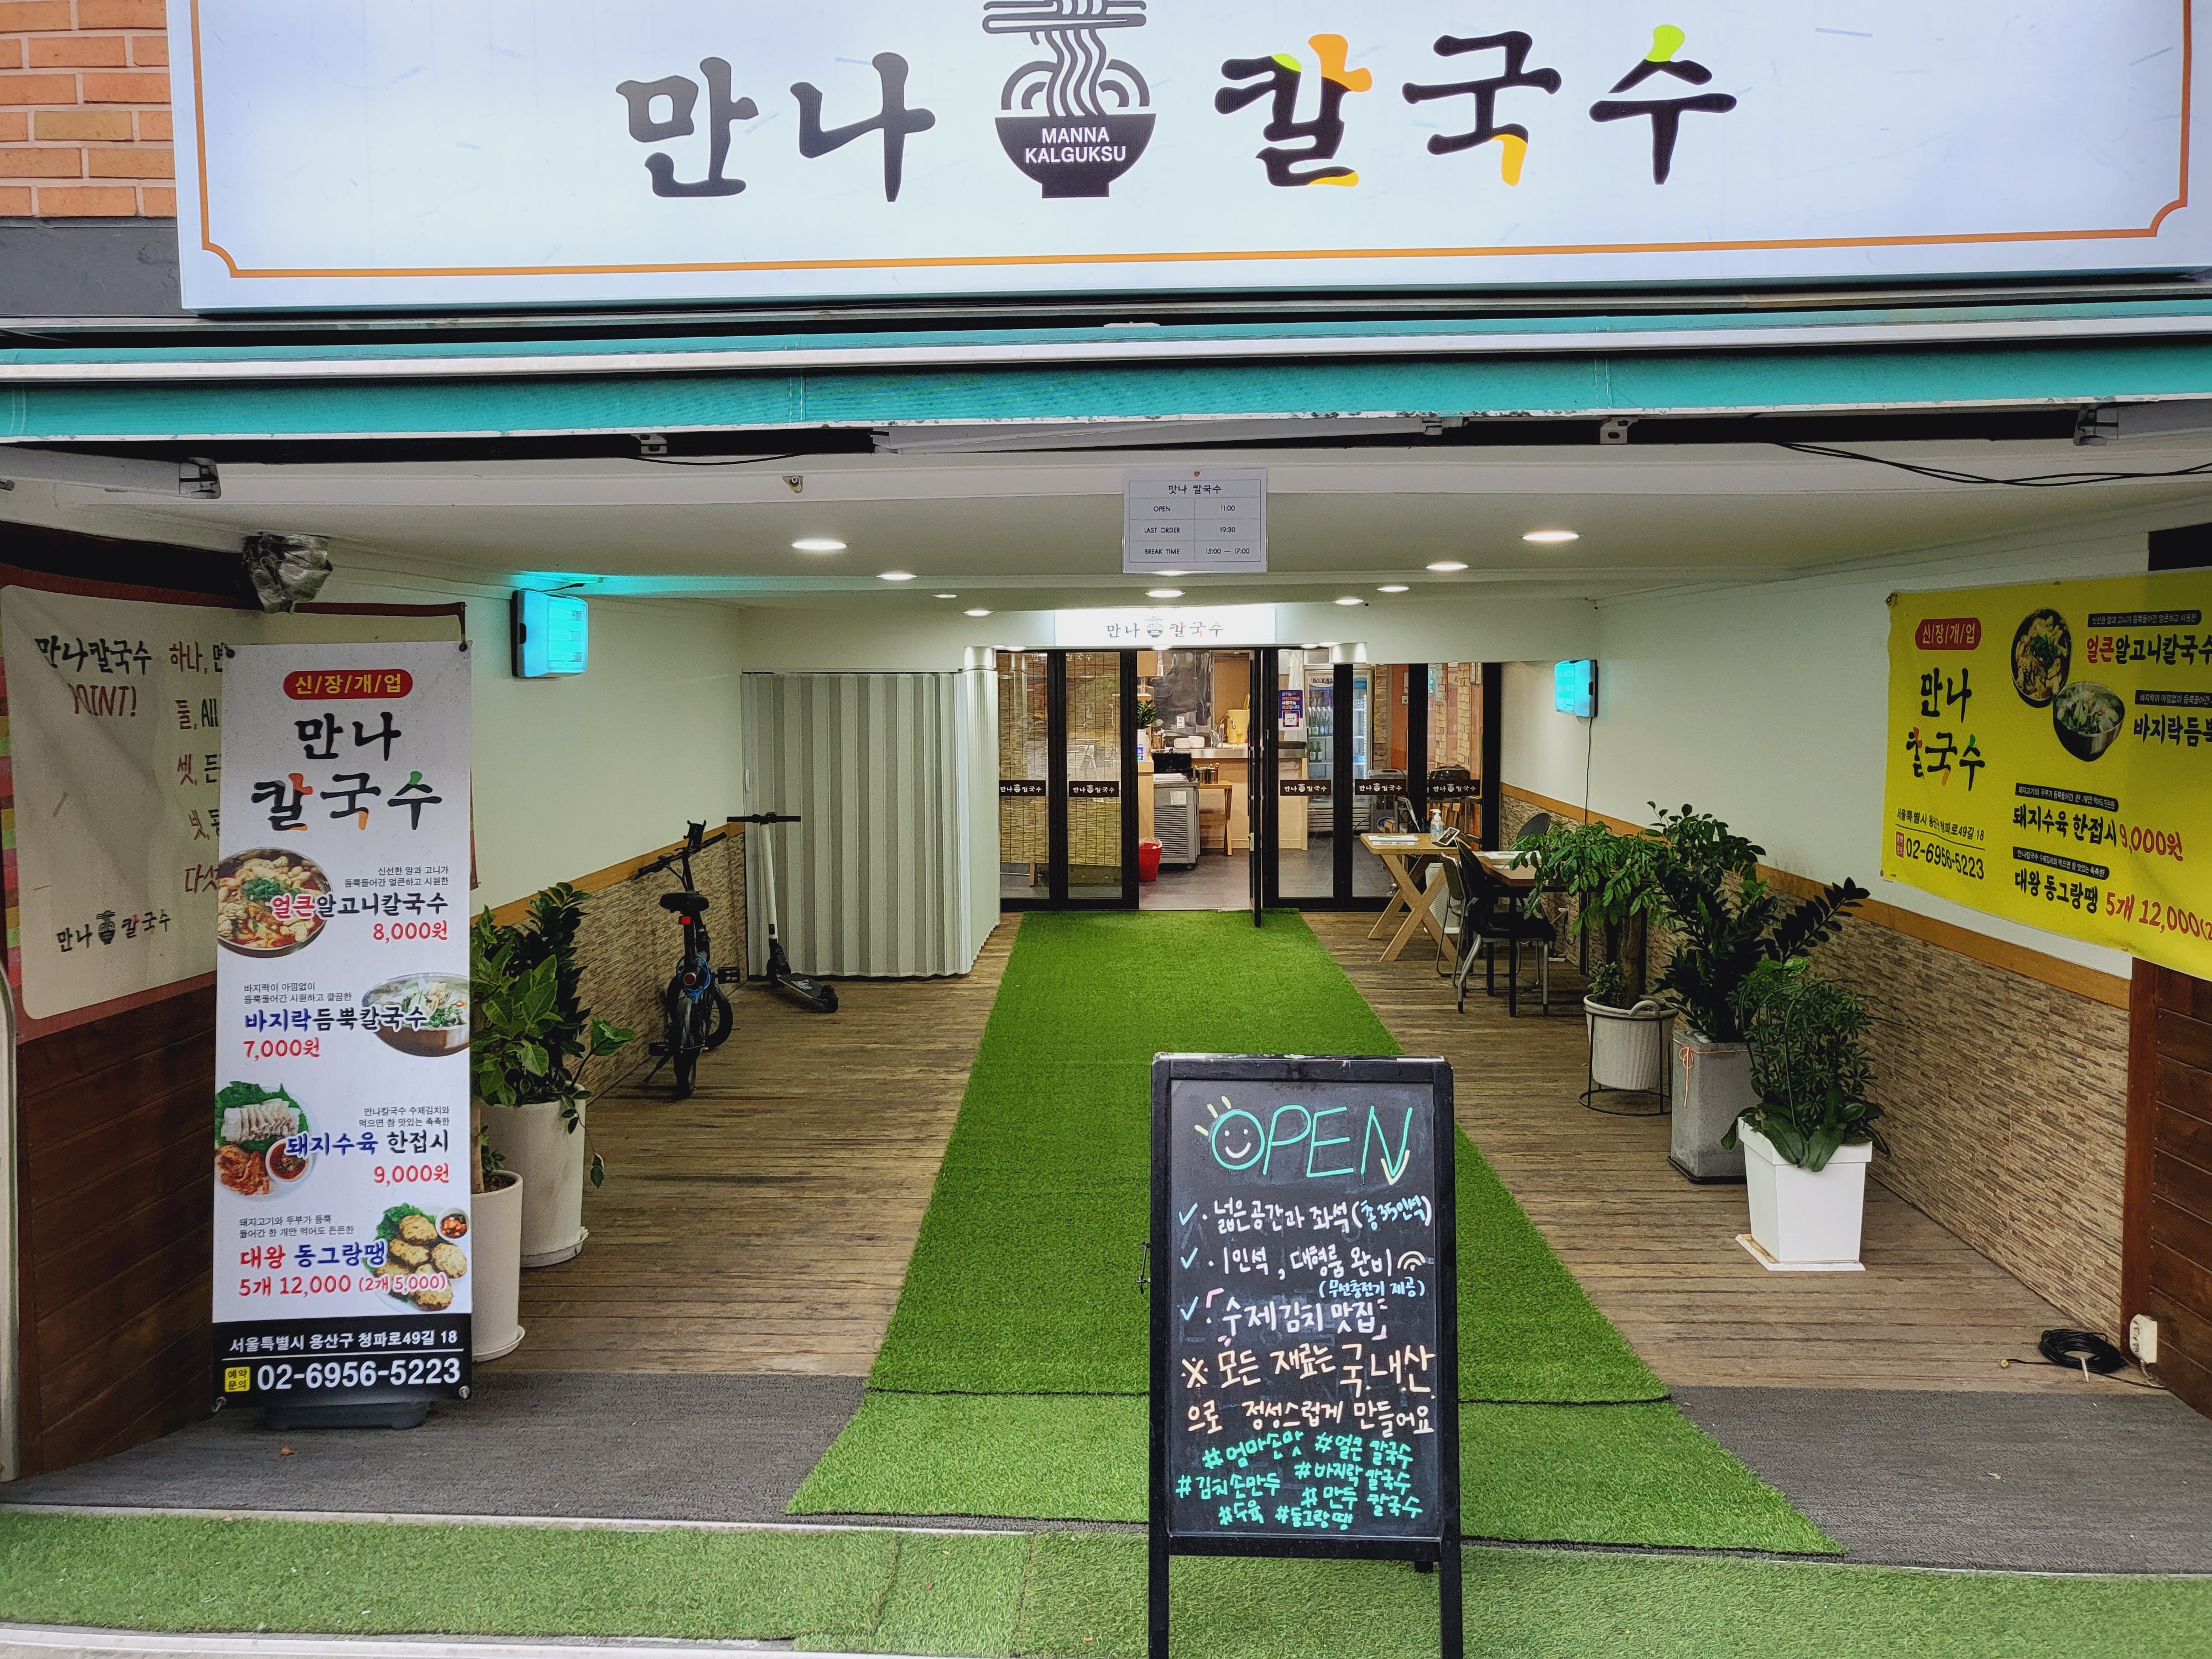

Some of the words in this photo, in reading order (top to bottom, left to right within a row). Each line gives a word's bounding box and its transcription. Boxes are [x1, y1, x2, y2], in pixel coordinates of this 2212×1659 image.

[616, 52, 935, 201] 만나
[1215, 24, 1736, 186] 칼국수
[1041, 127, 1110, 144] MANNA
[1025, 145, 1126, 163] KALGUKSU
[1168, 484, 1187, 494] 맛나
[1193, 484, 1222, 494] 칼국수
[1107, 623, 1140, 638] 만나
[1170, 621, 1224, 638] 칼국수
[2117, 615, 2131, 624] 고니가
[2159, 614, 2179, 623] 얼큰하고
[2180, 613, 2196, 622] 시원한
[1922, 622, 1975, 644] 신/장/개/업
[34, 635, 152, 675] 만나칼국수
[2087, 633, 2212, 666] 얼큰알고니칼국수
[295, 674, 401, 694] 신/장/개/업
[1921, 667, 1972, 723] 만나
[2140, 693, 2160, 702] 바지락이
[175, 700, 197, 730] 둘,
[295, 712, 401, 761] 만나
[251, 771, 442, 831] 칼국수
[1976, 830, 1984, 841] 18
[2012, 803, 2069, 838] 돼지수육
[2073, 813, 2117, 848] 한접시
[2119, 823, 2183, 862] 9,000원
[378, 867, 402, 875] 신선한
[405, 866, 421, 875] 알과
[425, 865, 448, 874] 고니가
[1906, 837, 1985, 880] 02-6956-5223
[344, 878, 386, 888] 듬뿍들어간
[389, 878, 422, 886] 얼큰하고
[424, 877, 448, 885] 시원한
[2015, 867, 2041, 897] 대왕
[2044, 874, 2098, 914] 동그랑땡
[2105, 891, 2135, 924] 5개
[272, 891, 449, 920] 얼큰알고니칼국수
[56, 924, 92, 952] 만나
[121, 909, 170, 939] 칼국수
[373, 920, 447, 943] 8,000원
[244, 983, 278, 993] 바지락이
[281, 982, 315, 992] 아낌없이
[290, 993, 324, 1003] 시원하고
[327, 992, 352, 1001] 깔끔한
[244, 1005, 428, 1033] 바지락듬뿍칼국수
[243, 1036, 320, 1061] 7,000원
[359, 1119, 384, 1128] 먹으면
[387, 1118, 395, 1127] 참
[398, 1118, 422, 1127] 맛있는
[425, 1117, 450, 1126] 촉촉한
[364, 1107, 406, 1117] 만나칼국수
[409, 1106, 450, 1115] 수제김치와
[285, 1131, 379, 1156] 돼지수육
[387, 1129, 449, 1154] 한접시
[1211, 1104, 1413, 1178] OPEN
[374, 1162, 449, 1187] 9,000원
[239, 1216, 283, 1227] 돼지고기와
[286, 1215, 311, 1225] 두부가
[315, 1214, 331, 1224] 듬뿍
[1214, 1196, 1250, 1234] 넓은
[1251, 1200, 1305, 1232] 공간과
[239, 1229, 265, 1239] 들어간
[269, 1228, 277, 1238] 한
[280, 1227, 297, 1237] 개만
[300, 1227, 325, 1236] 먹어도
[328, 1225, 354, 1235] 든든한
[240, 1244, 286, 1270] 대왕
[293, 1241, 387, 1269] 동그랑땡
[1290, 1244, 1345, 1279] 대형룸
[1350, 1246, 1392, 1277] 완비
[238, 1276, 271, 1297] 5개
[279, 1275, 351, 1298] 12,000
[358, 1275, 388, 1293] (2개
[393, 1274, 447, 1295] 5,000)
[1389, 1276, 1426, 1298] 제공)
[229, 1334, 304, 1353] 서울특별시
[309, 1333, 354, 1350] 용산구
[358, 1330, 435, 1347] 청파로49길
[441, 1329, 458, 1344] 18
[257, 1357, 461, 1391] 02-6956-5223
[1218, 1348, 1261, 1389] 모든
[1270, 1343, 1337, 1380] 재료는
[1188, 1400, 1223, 1434] 으로
[1241, 1400, 1344, 1431] 정성스럽게
[1354, 1400, 1435, 1438] 만들어요
[1369, 1439, 1413, 1470] 칼국수
[1365, 1469, 1412, 1495] 칼국수
[1366, 1493, 1423, 1519] 칼국수
